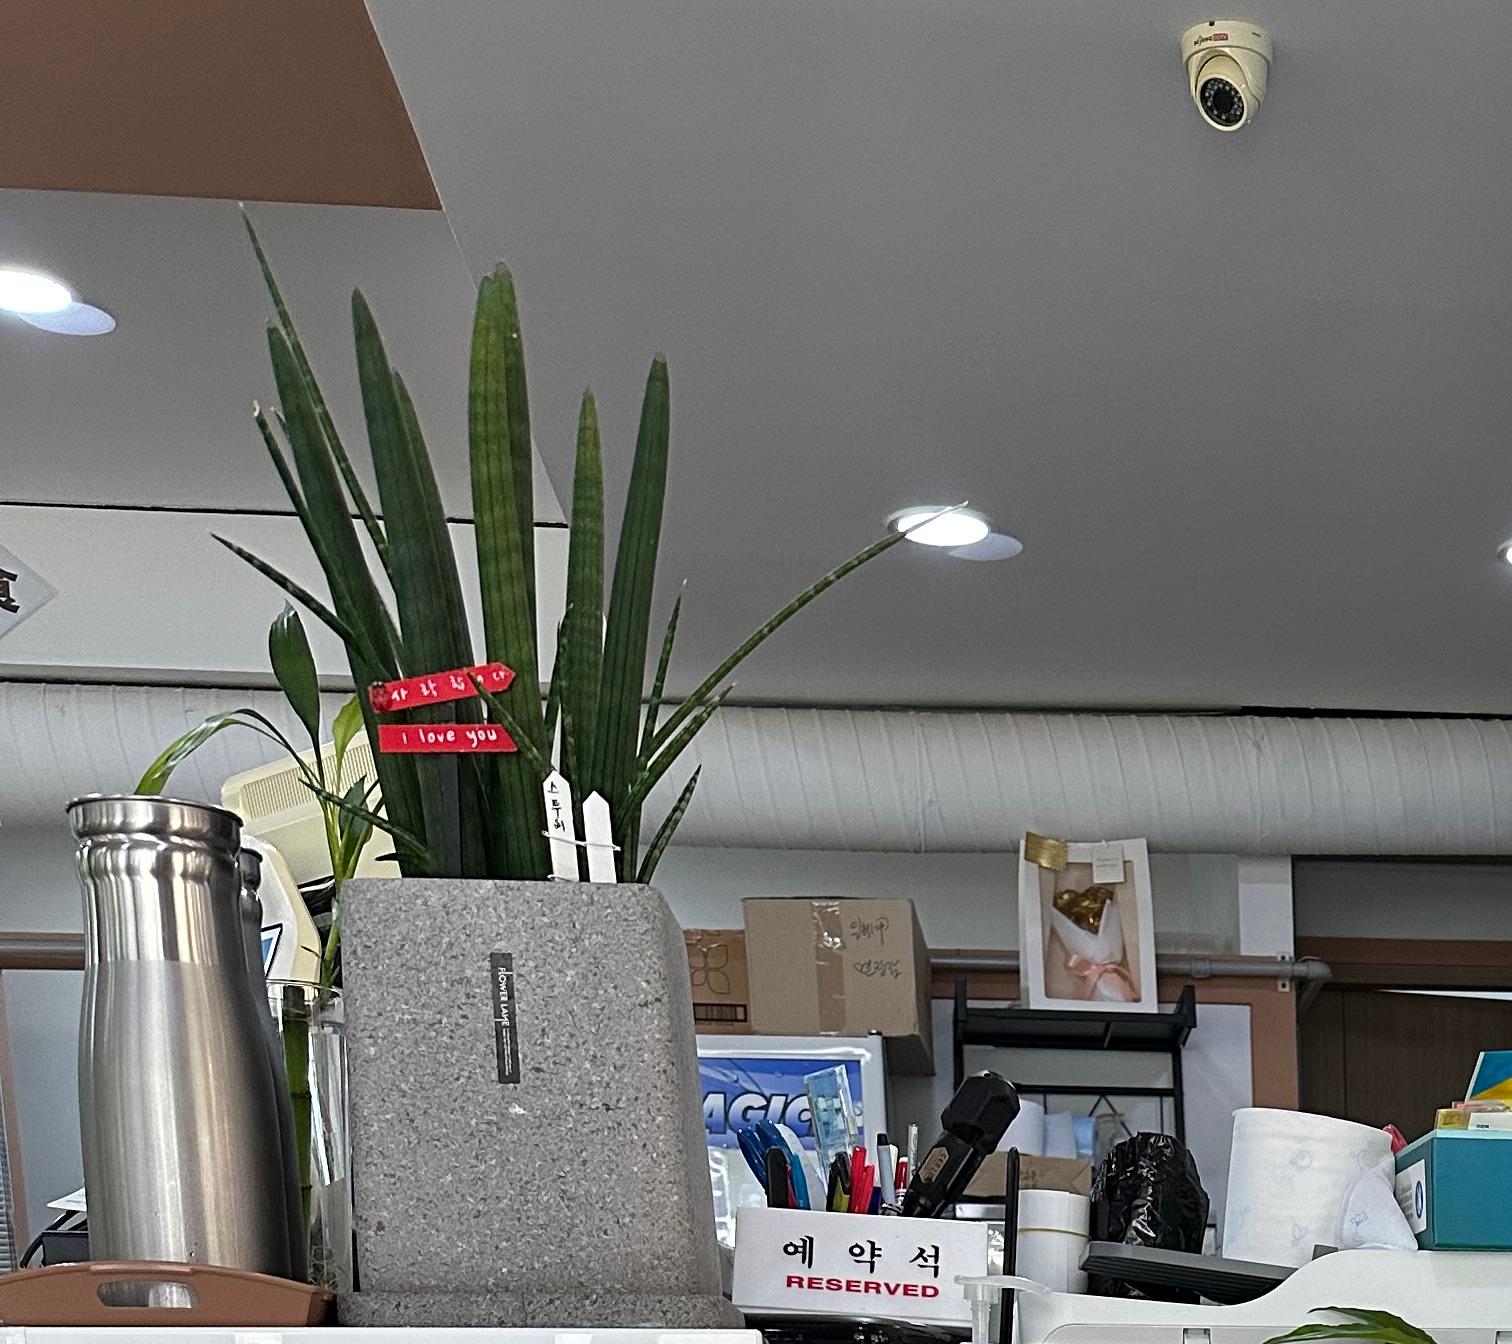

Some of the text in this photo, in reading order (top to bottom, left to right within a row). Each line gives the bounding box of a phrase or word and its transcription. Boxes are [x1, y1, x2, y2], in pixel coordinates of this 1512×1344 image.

[419, 729, 456, 744] love
[465, 730, 498, 748] you
[785, 1275, 940, 1298] RESERVED
